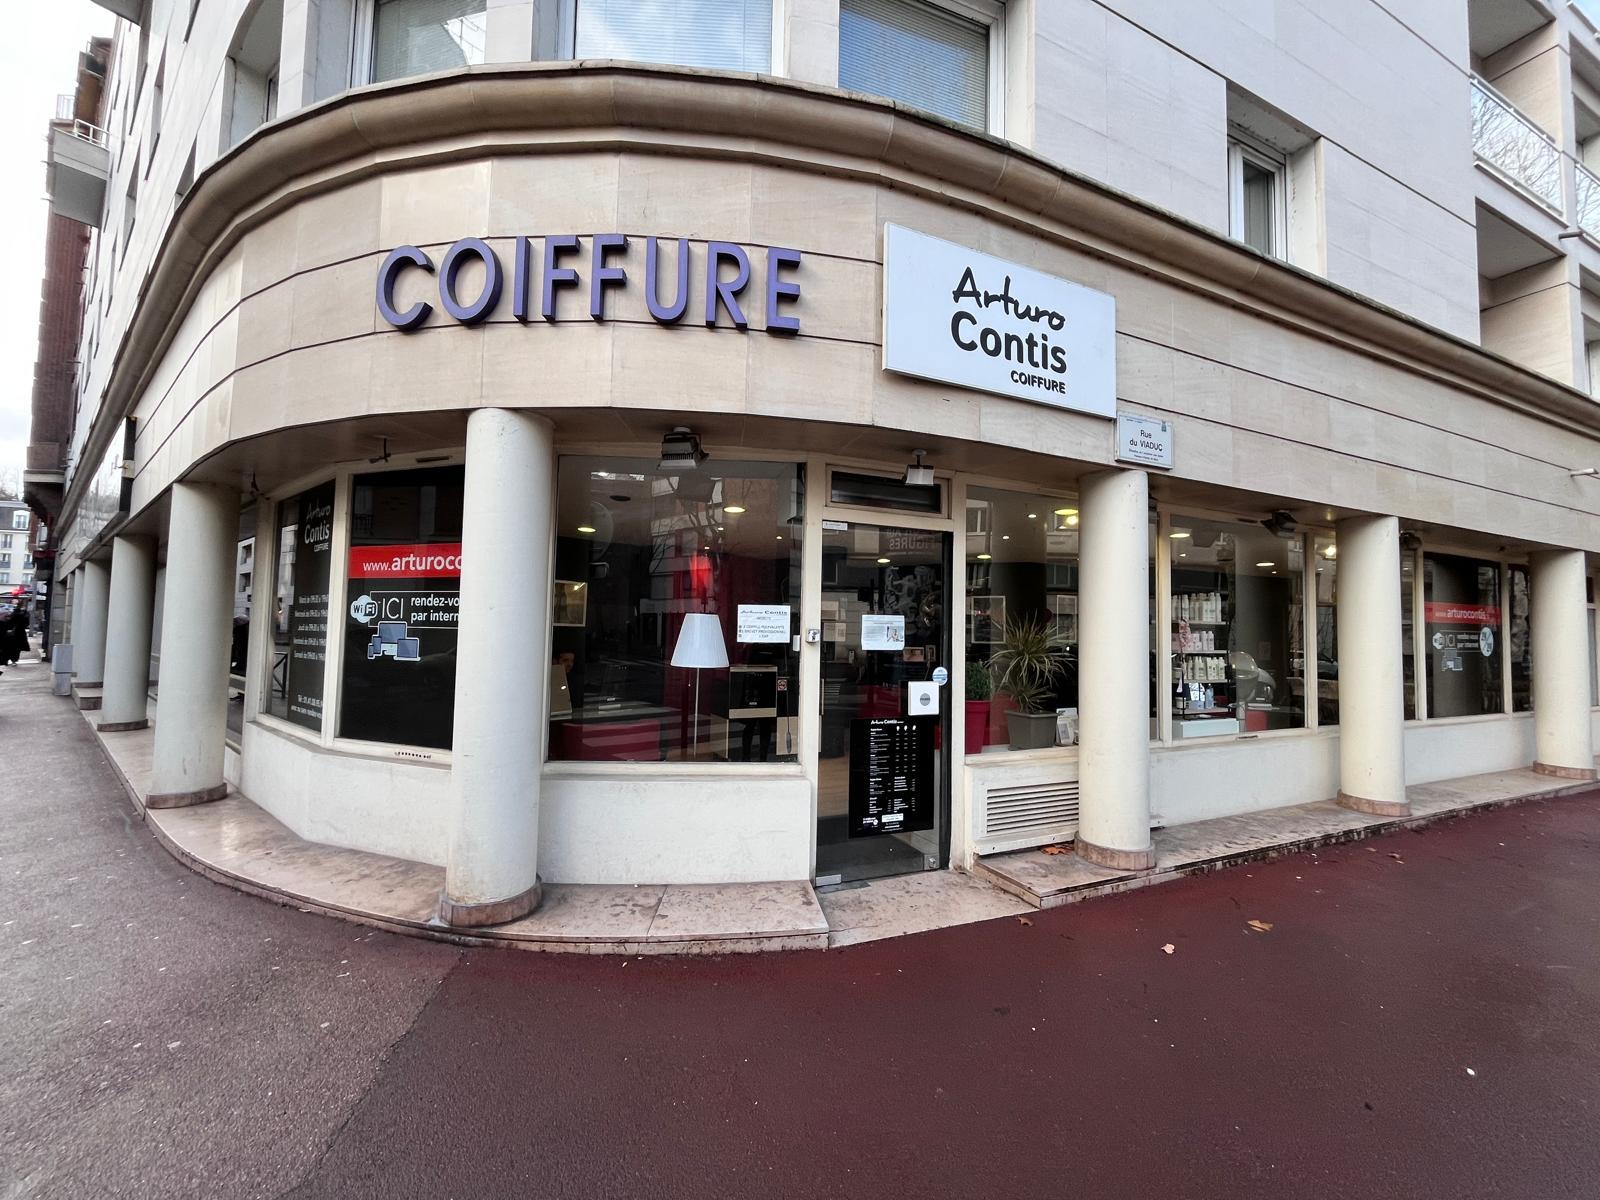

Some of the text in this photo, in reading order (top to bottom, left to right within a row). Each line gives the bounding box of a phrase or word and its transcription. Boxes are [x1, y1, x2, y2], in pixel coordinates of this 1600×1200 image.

[376, 233, 801, 335] COIFFURE
[952, 266, 1066, 331] Arturo
[951, 310, 1067, 374] Contis
[1010, 370, 1066, 394] COIFFURE
[1129, 438, 1163, 452] du VIADUC
[1140, 429, 1152, 438] Rue
[304, 520, 330, 544] Contis
[382, 598, 404, 619] ICI
[411, 612, 428, 624] par
